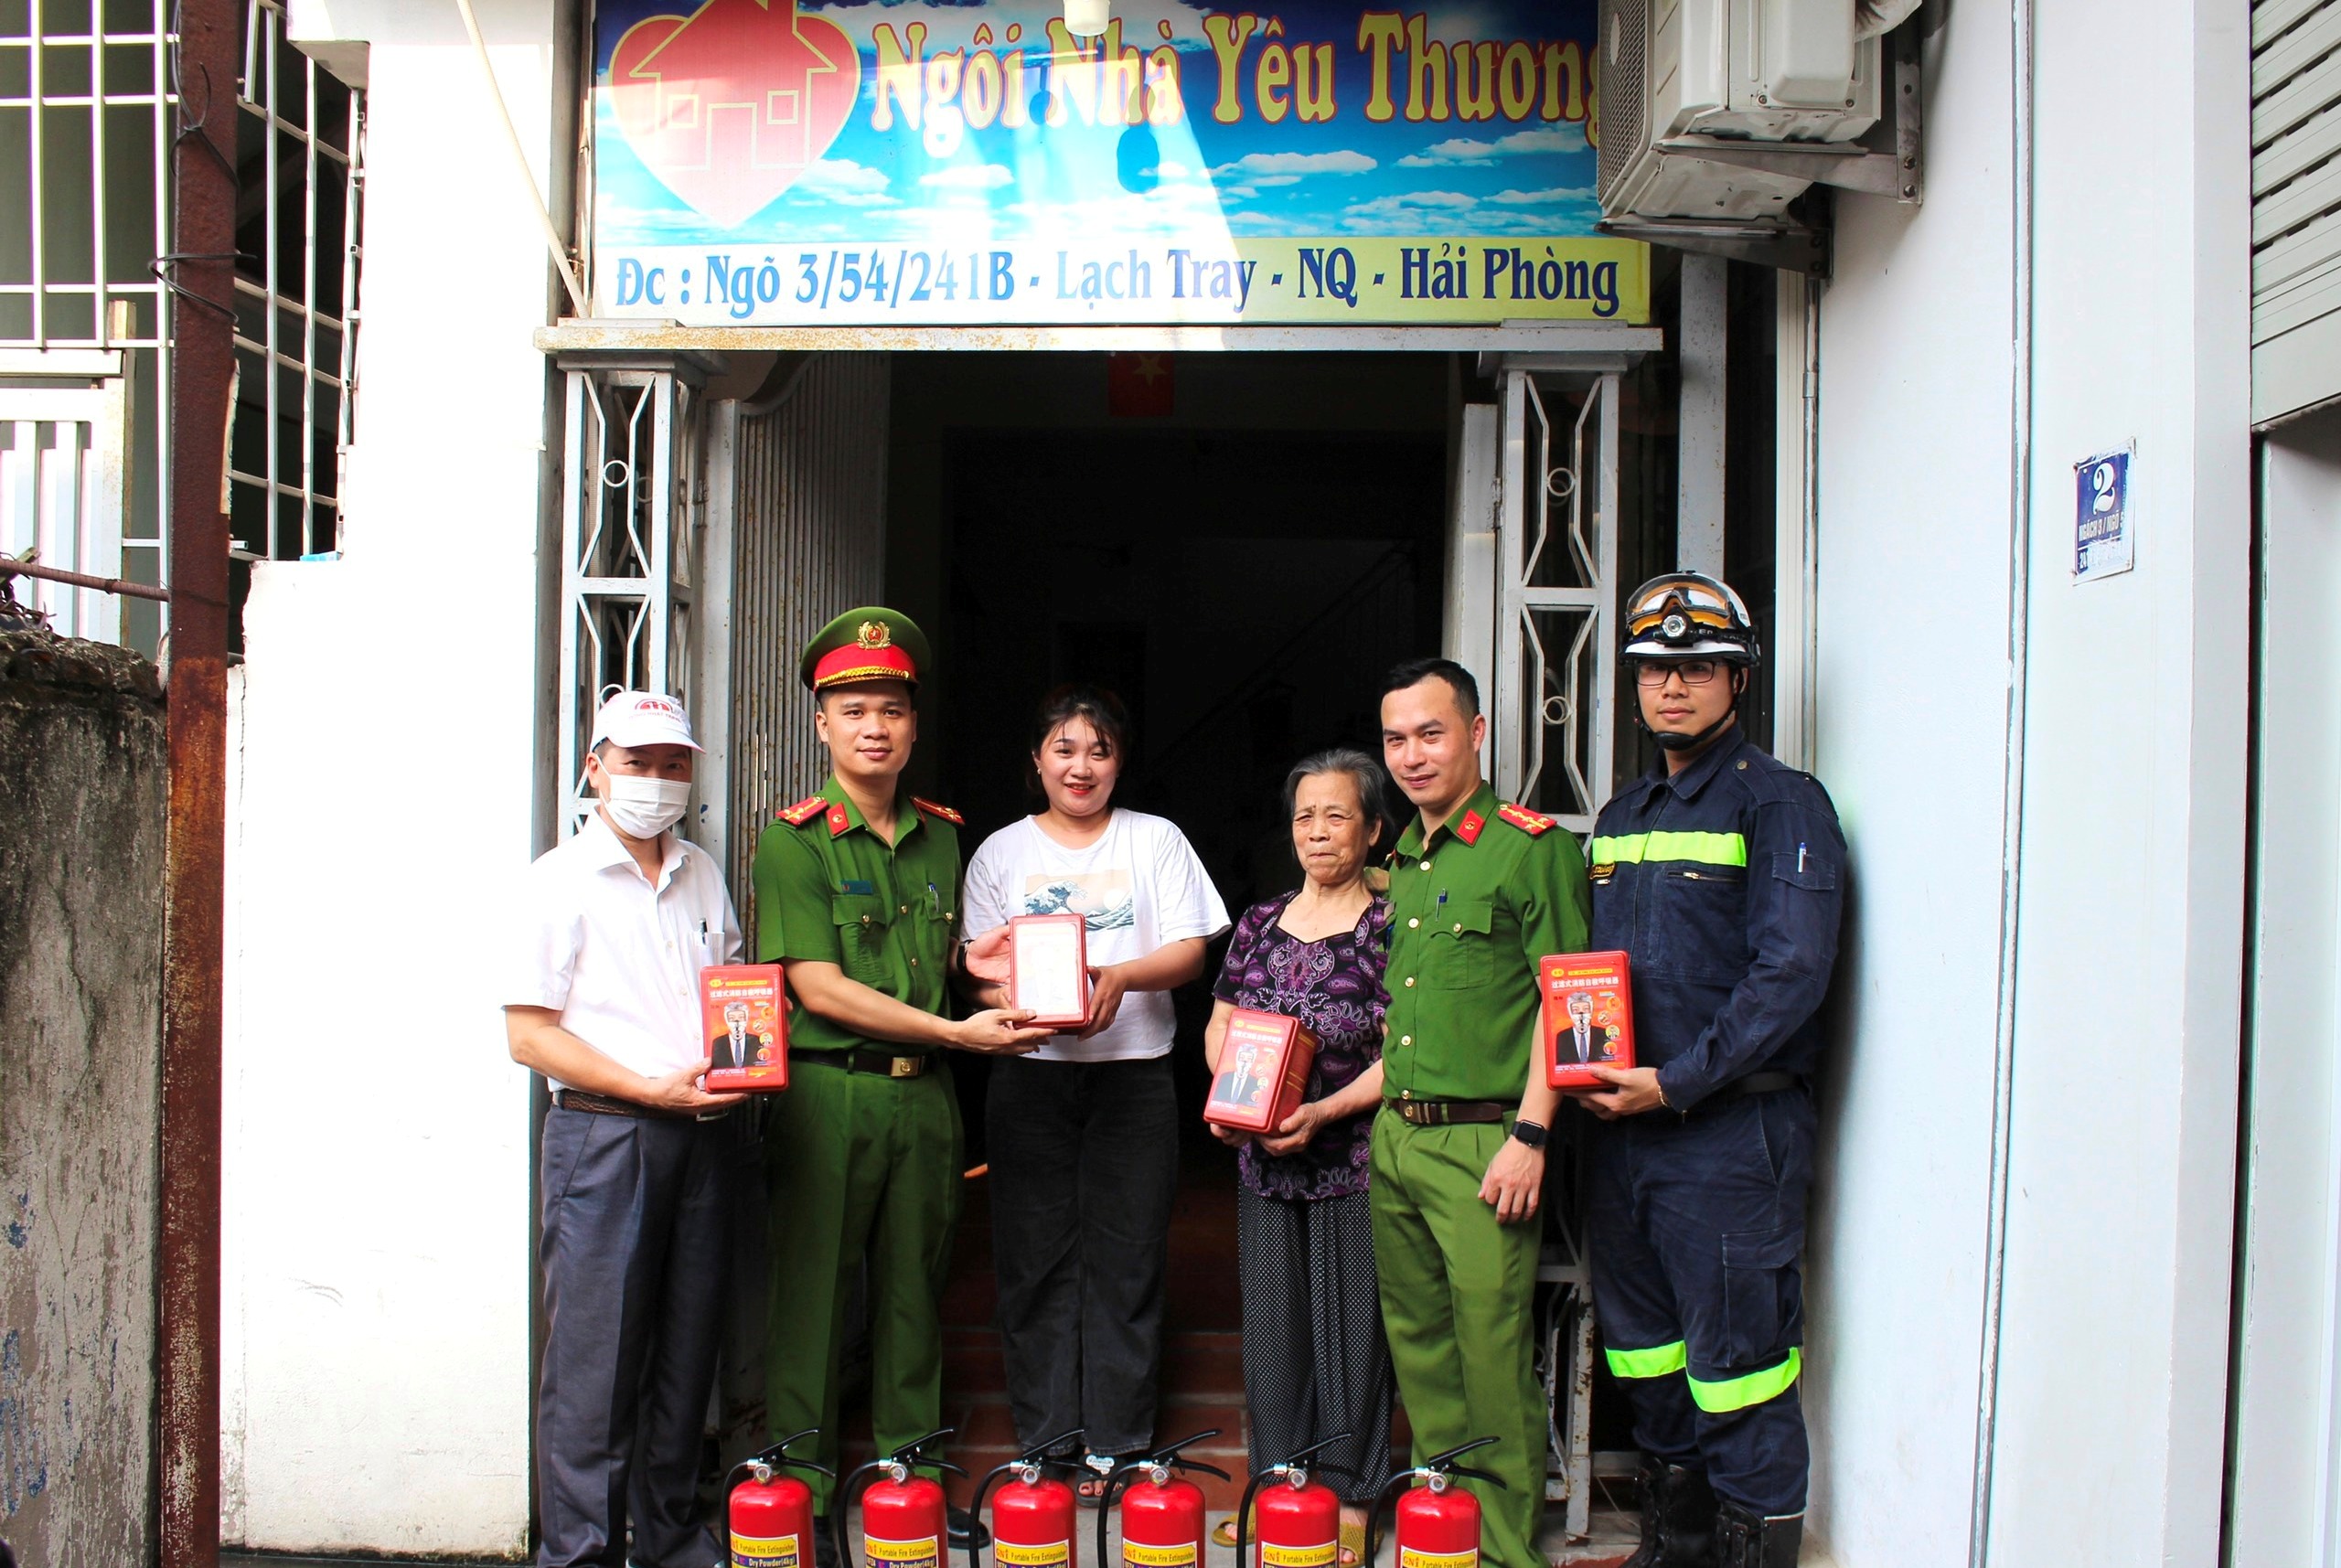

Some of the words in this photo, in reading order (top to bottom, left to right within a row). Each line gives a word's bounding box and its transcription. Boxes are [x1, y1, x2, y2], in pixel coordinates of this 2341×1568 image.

[871, 20, 1026, 159] Ngôi
[1045, 16, 1183, 127] Nhà
[1203, 12, 1338, 124] Yêu
[615, 256, 666, 306] Đc
[704, 254, 781, 320] Ngõ
[795, 248, 1015, 310] 3/54/241B
[1055, 249, 1152, 312] Lạch
[1166, 248, 1257, 314] Tray
[1297, 247, 1359, 308] NQ
[1400, 241, 1468, 302] Hải
[1482, 246, 1621, 318] Phòng
[2092, 462, 2116, 516] 2
